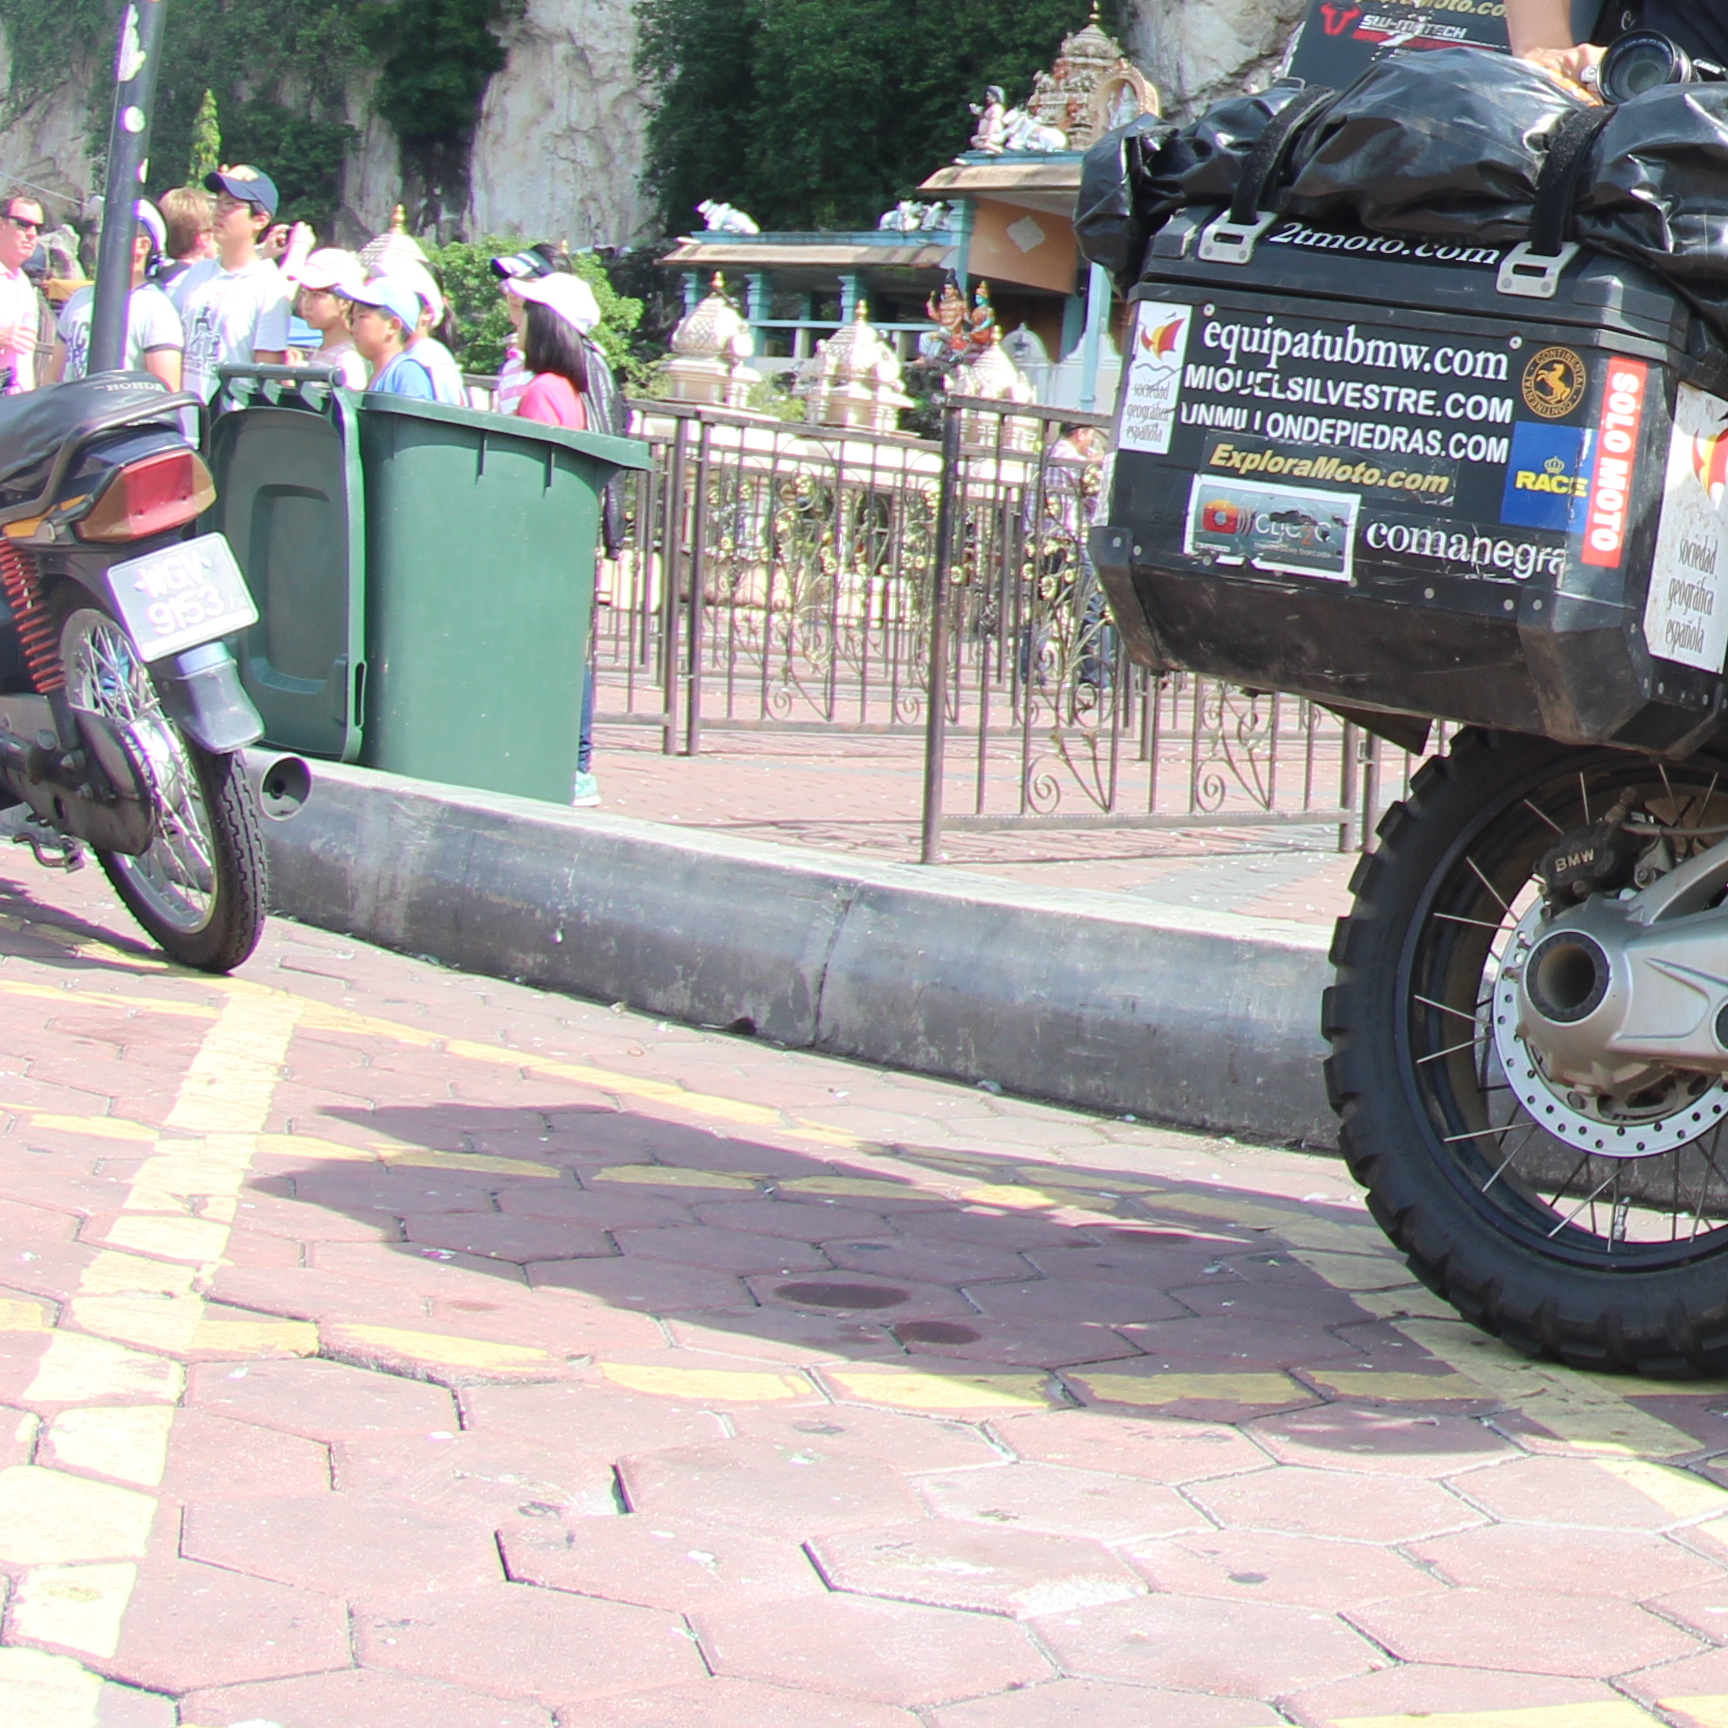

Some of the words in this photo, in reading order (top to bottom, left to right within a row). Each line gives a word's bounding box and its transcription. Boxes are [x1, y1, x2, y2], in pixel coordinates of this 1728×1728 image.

[1267, 221, 1500, 266] 2tmoto.com
[1203, 315, 1510, 382] equipatubmw.com
[106, 380, 168, 394] HONDA
[1604, 371, 1640, 452] SOLO
[1208, 442, 1451, 495] ExploraMoto.com
[1515, 469, 1589, 498] RACE
[1591, 457, 1629, 553] MOTO
[1366, 520, 1569, 580] comanegra
[1677, 536, 1719, 573] sociedad
[148, 583, 225, 635] 9153
[1554, 848, 1595, 873] BMW
